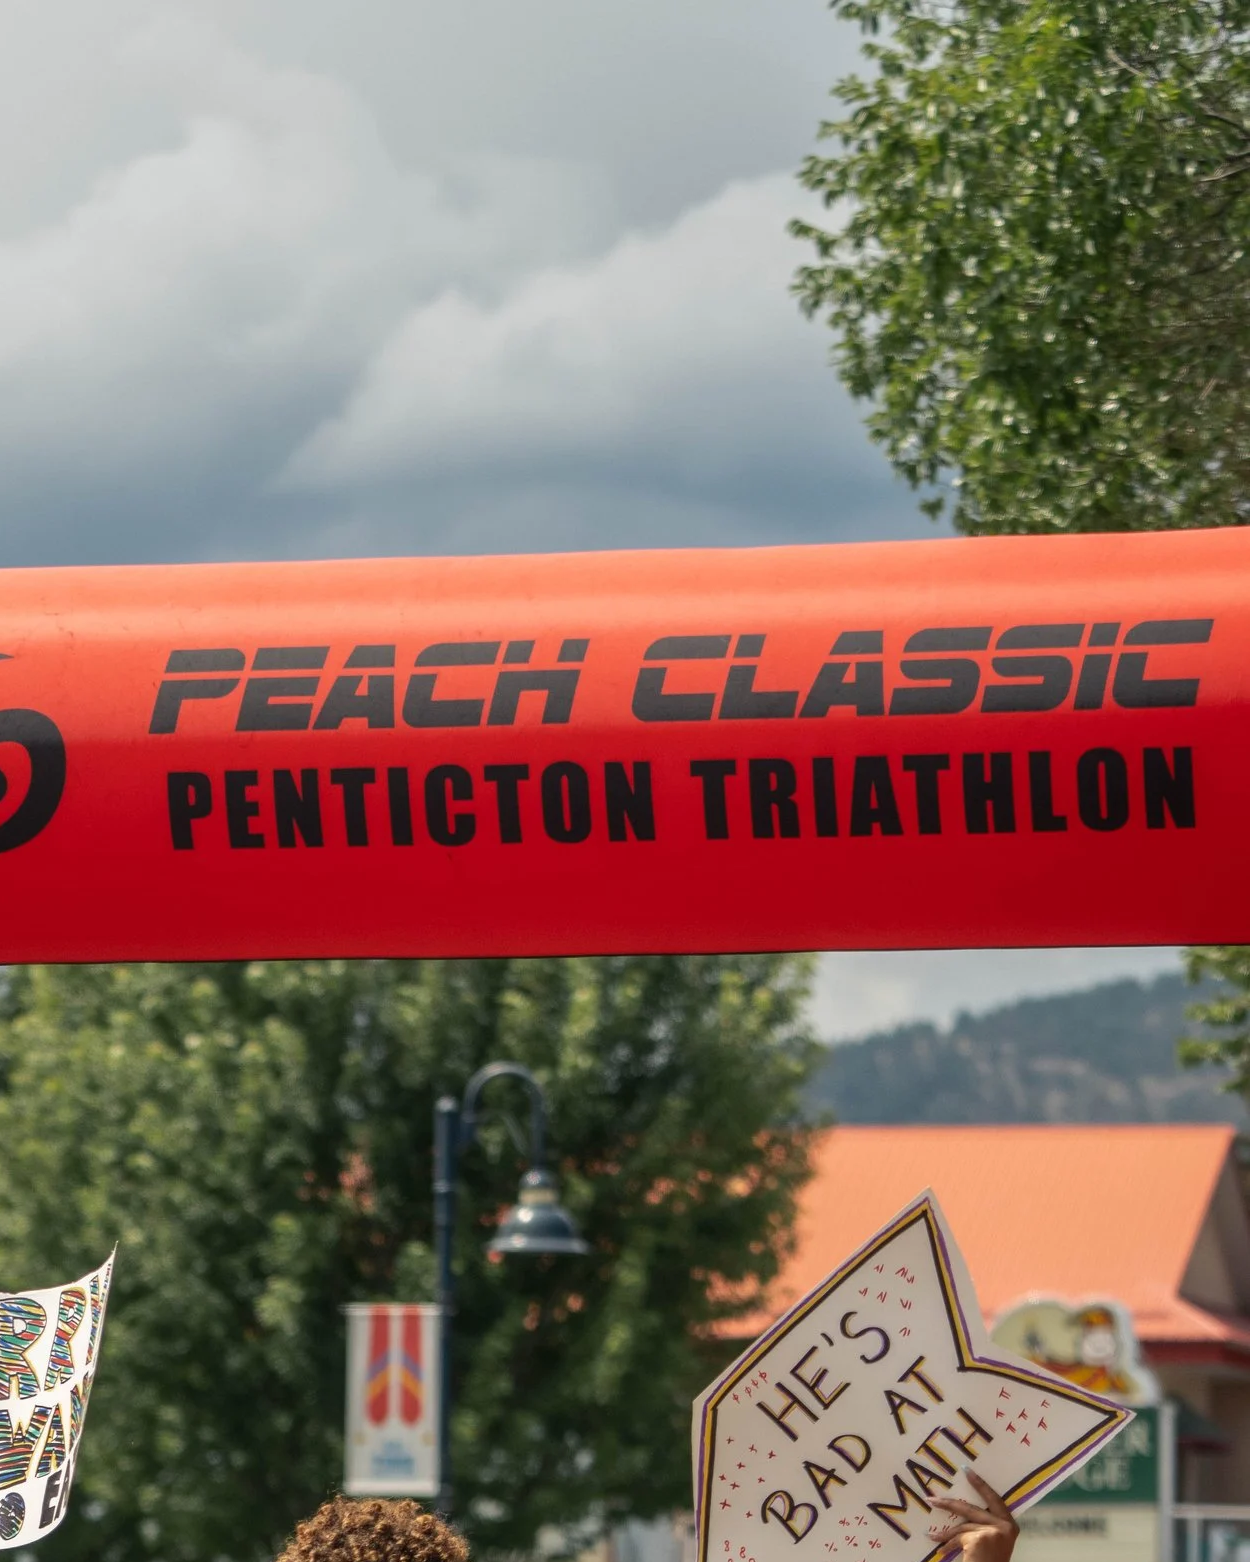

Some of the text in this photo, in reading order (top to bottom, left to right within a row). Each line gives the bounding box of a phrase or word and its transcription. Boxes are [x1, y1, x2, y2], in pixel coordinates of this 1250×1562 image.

[149, 618, 1215, 734] PEACH CLASSIC
[167, 745, 1199, 850] PENTICTON TRIATHLON
[756, 1311, 891, 1442] HE'S
[761, 1355, 944, 1544] BAD AT
[866, 1407, 994, 1541] MATH
